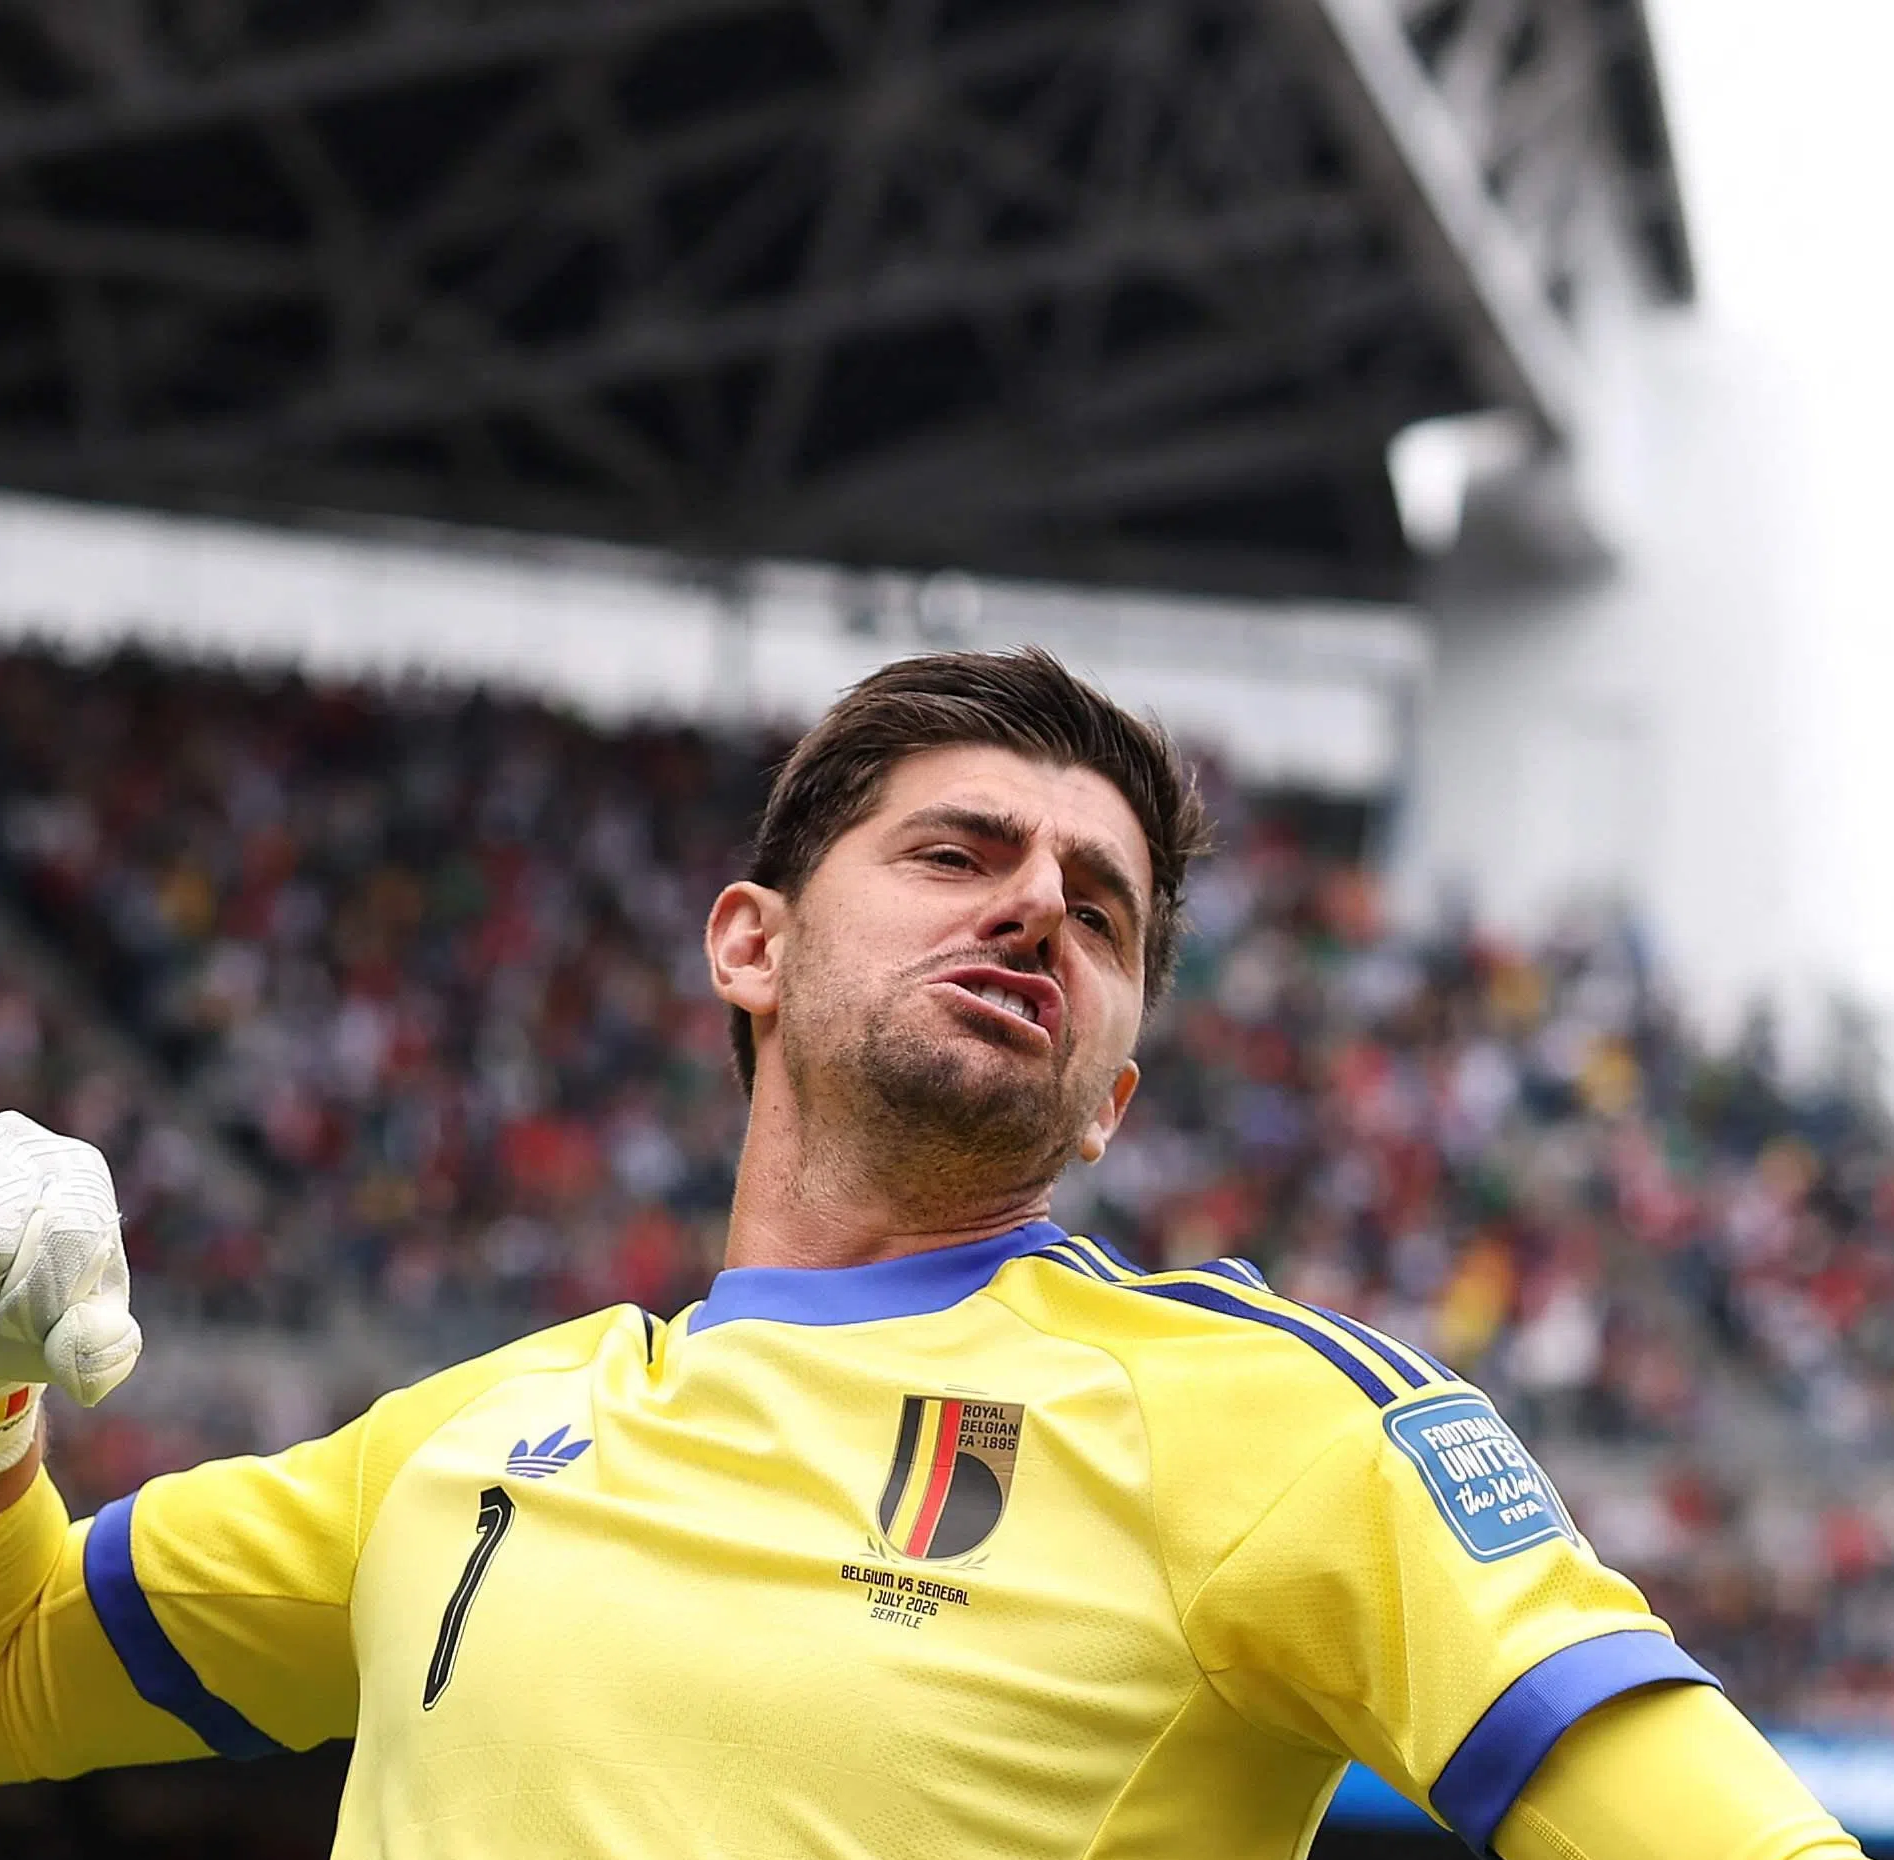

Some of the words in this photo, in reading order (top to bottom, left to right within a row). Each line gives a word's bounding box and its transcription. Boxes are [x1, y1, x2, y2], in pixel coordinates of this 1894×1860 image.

[962, 1404, 1006, 1420] ROYAL
[960, 1419, 1019, 1436] BELGIAN
[1420, 1416, 1508, 1450] FOOTBALL
[1455, 1483, 1495, 1515] the
[1498, 1499, 1543, 1525] FIFA
[423, 1485, 516, 1711] 1
[841, 1564, 894, 1588] BELGIUM
[898, 1575, 914, 1592] VS
[917, 1580, 970, 1606] SENEGAL
[867, 1587, 873, 1602] 1
[874, 1590, 904, 1608] JULY
[906, 1596, 939, 1616] 2026
[870, 1606, 923, 1629] SEATTLE
